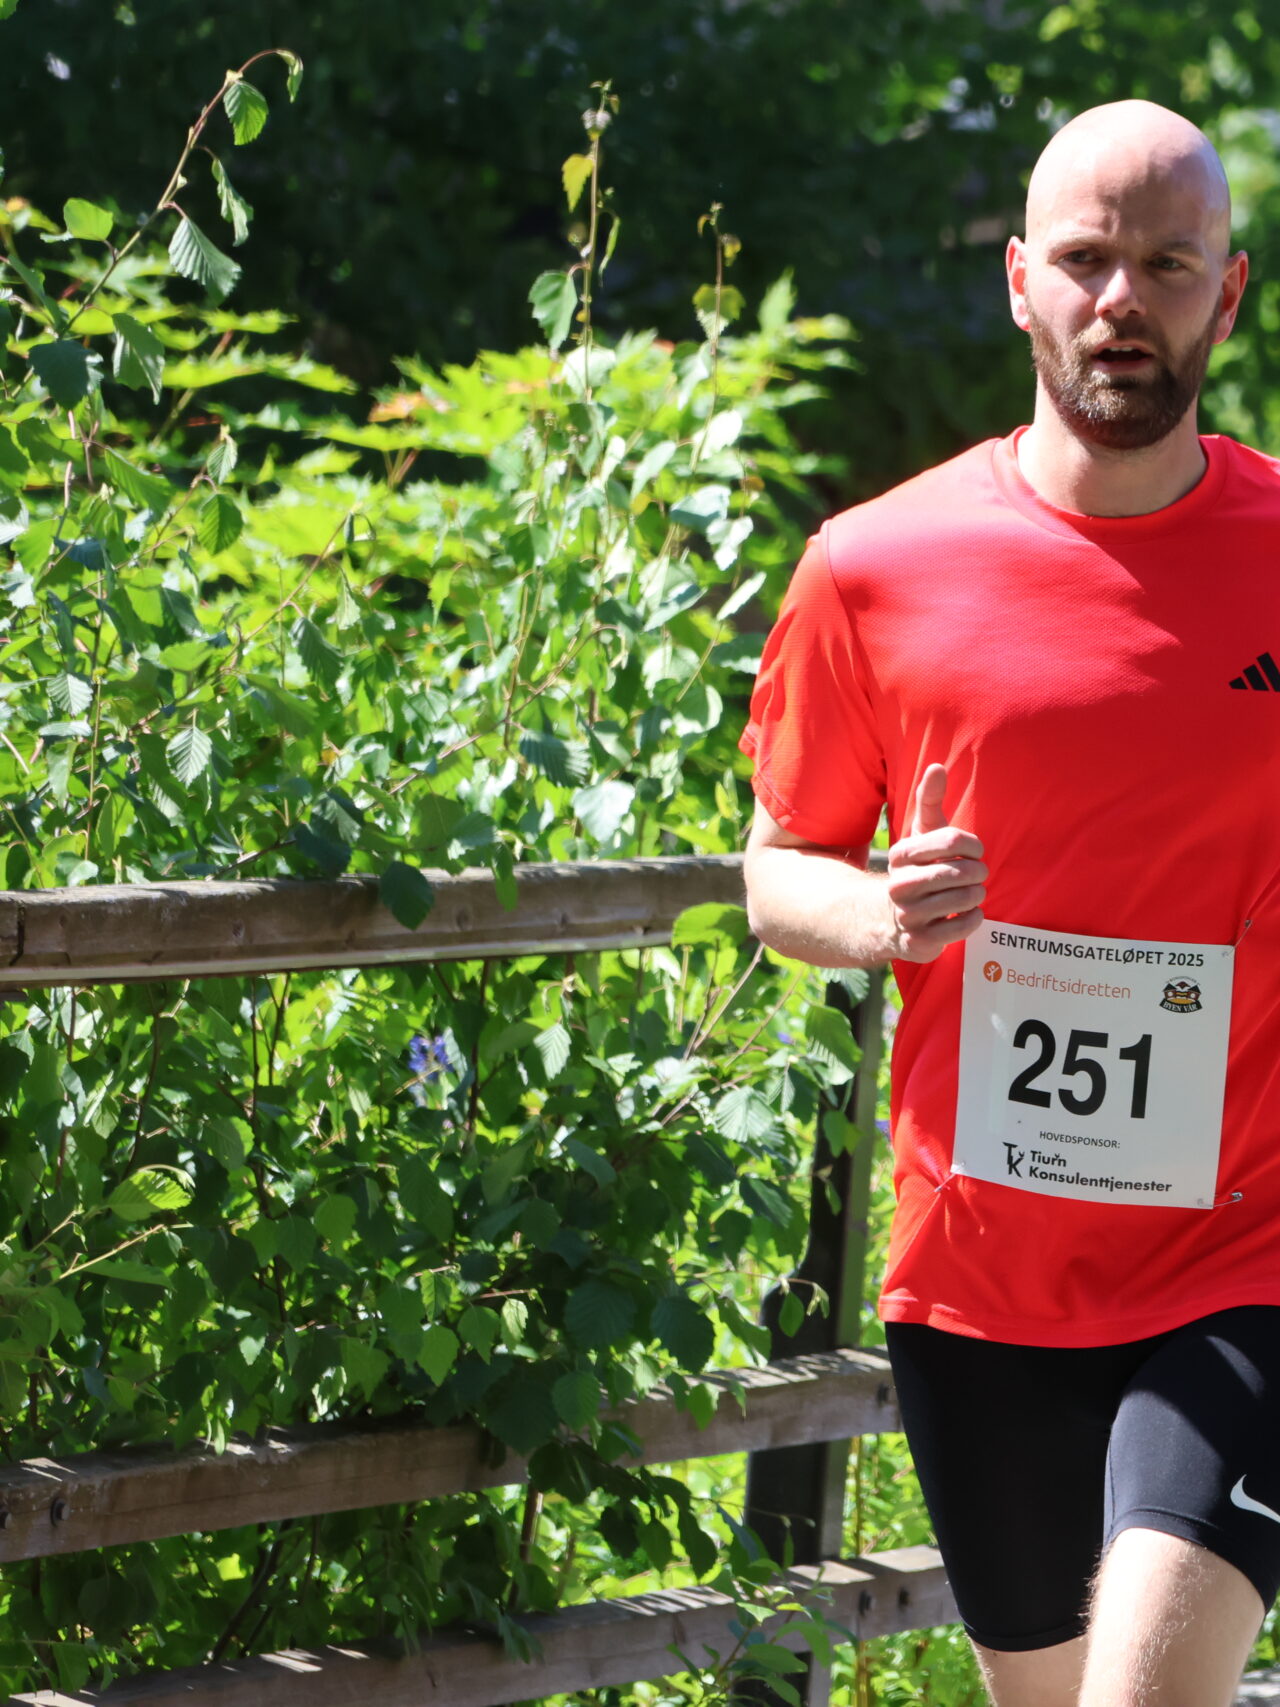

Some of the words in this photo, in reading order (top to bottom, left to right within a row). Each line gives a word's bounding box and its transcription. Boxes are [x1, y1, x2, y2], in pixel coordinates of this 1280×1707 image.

[990, 930, 1164, 965] SENTRUMSGATELØPET
[1167, 952, 1204, 967] 2025
[1006, 969, 1132, 999] Bedriftsidretten
[1008, 1019, 1153, 1119] 251
[1039, 1130, 1121, 1150] HOVEDSPONSOR:
[1028, 1165, 1173, 1192] Konsulenttjenester
